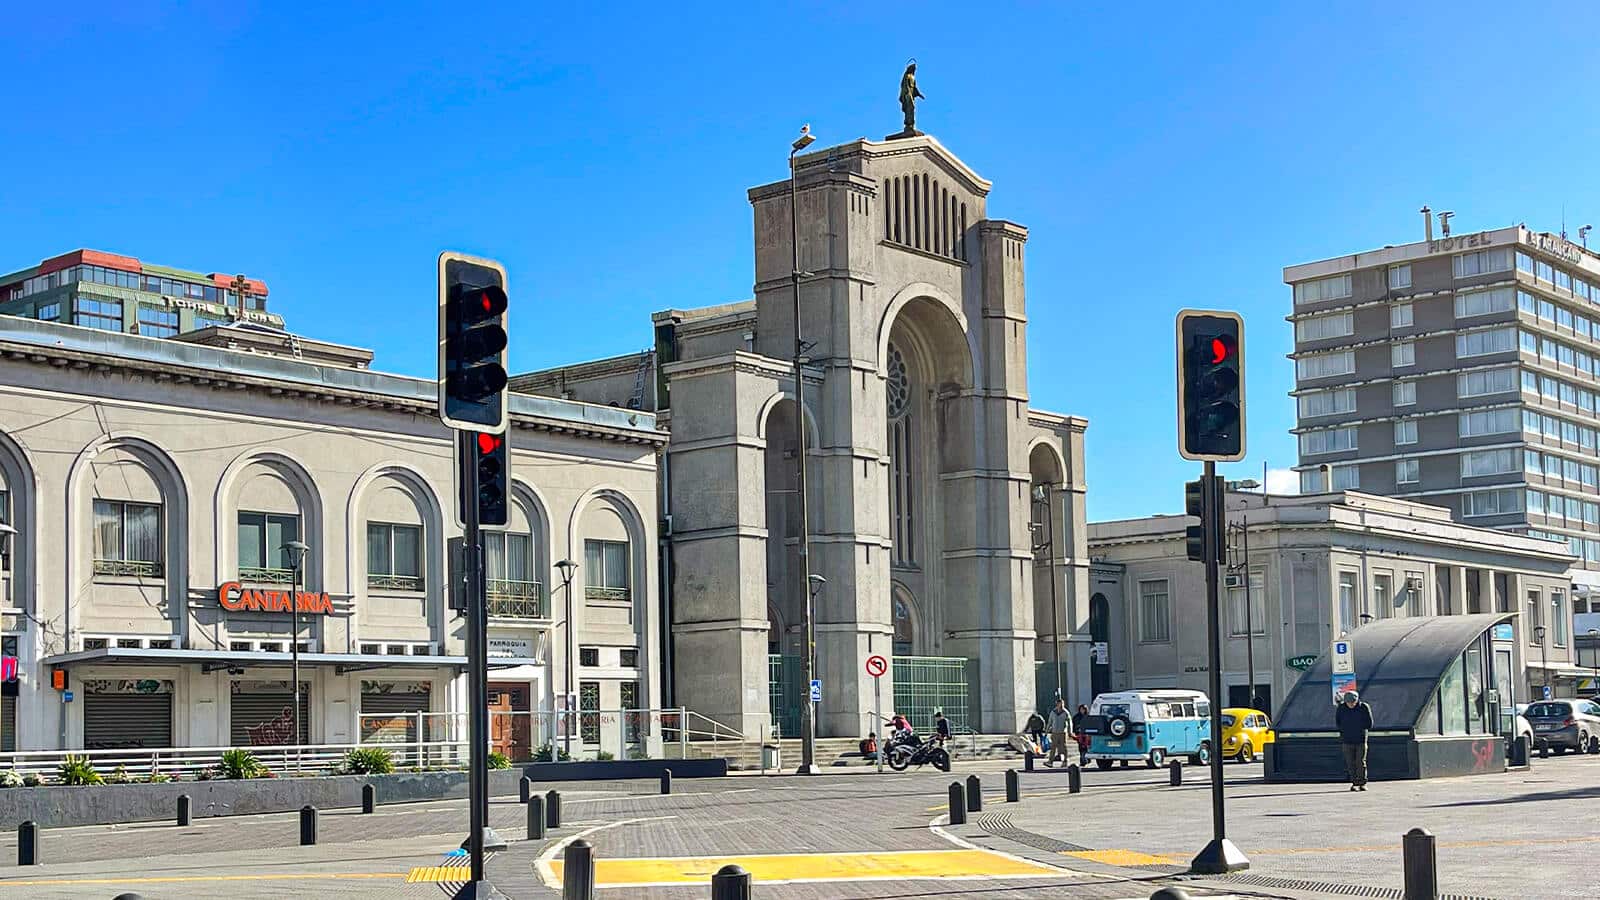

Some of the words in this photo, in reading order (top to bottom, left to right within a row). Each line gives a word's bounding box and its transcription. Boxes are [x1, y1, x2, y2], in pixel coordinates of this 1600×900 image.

[1427, 231, 1492, 254] HOTEL
[219, 582, 334, 616] CANTABRIA
[489, 640, 527, 648] PARROQUIA
